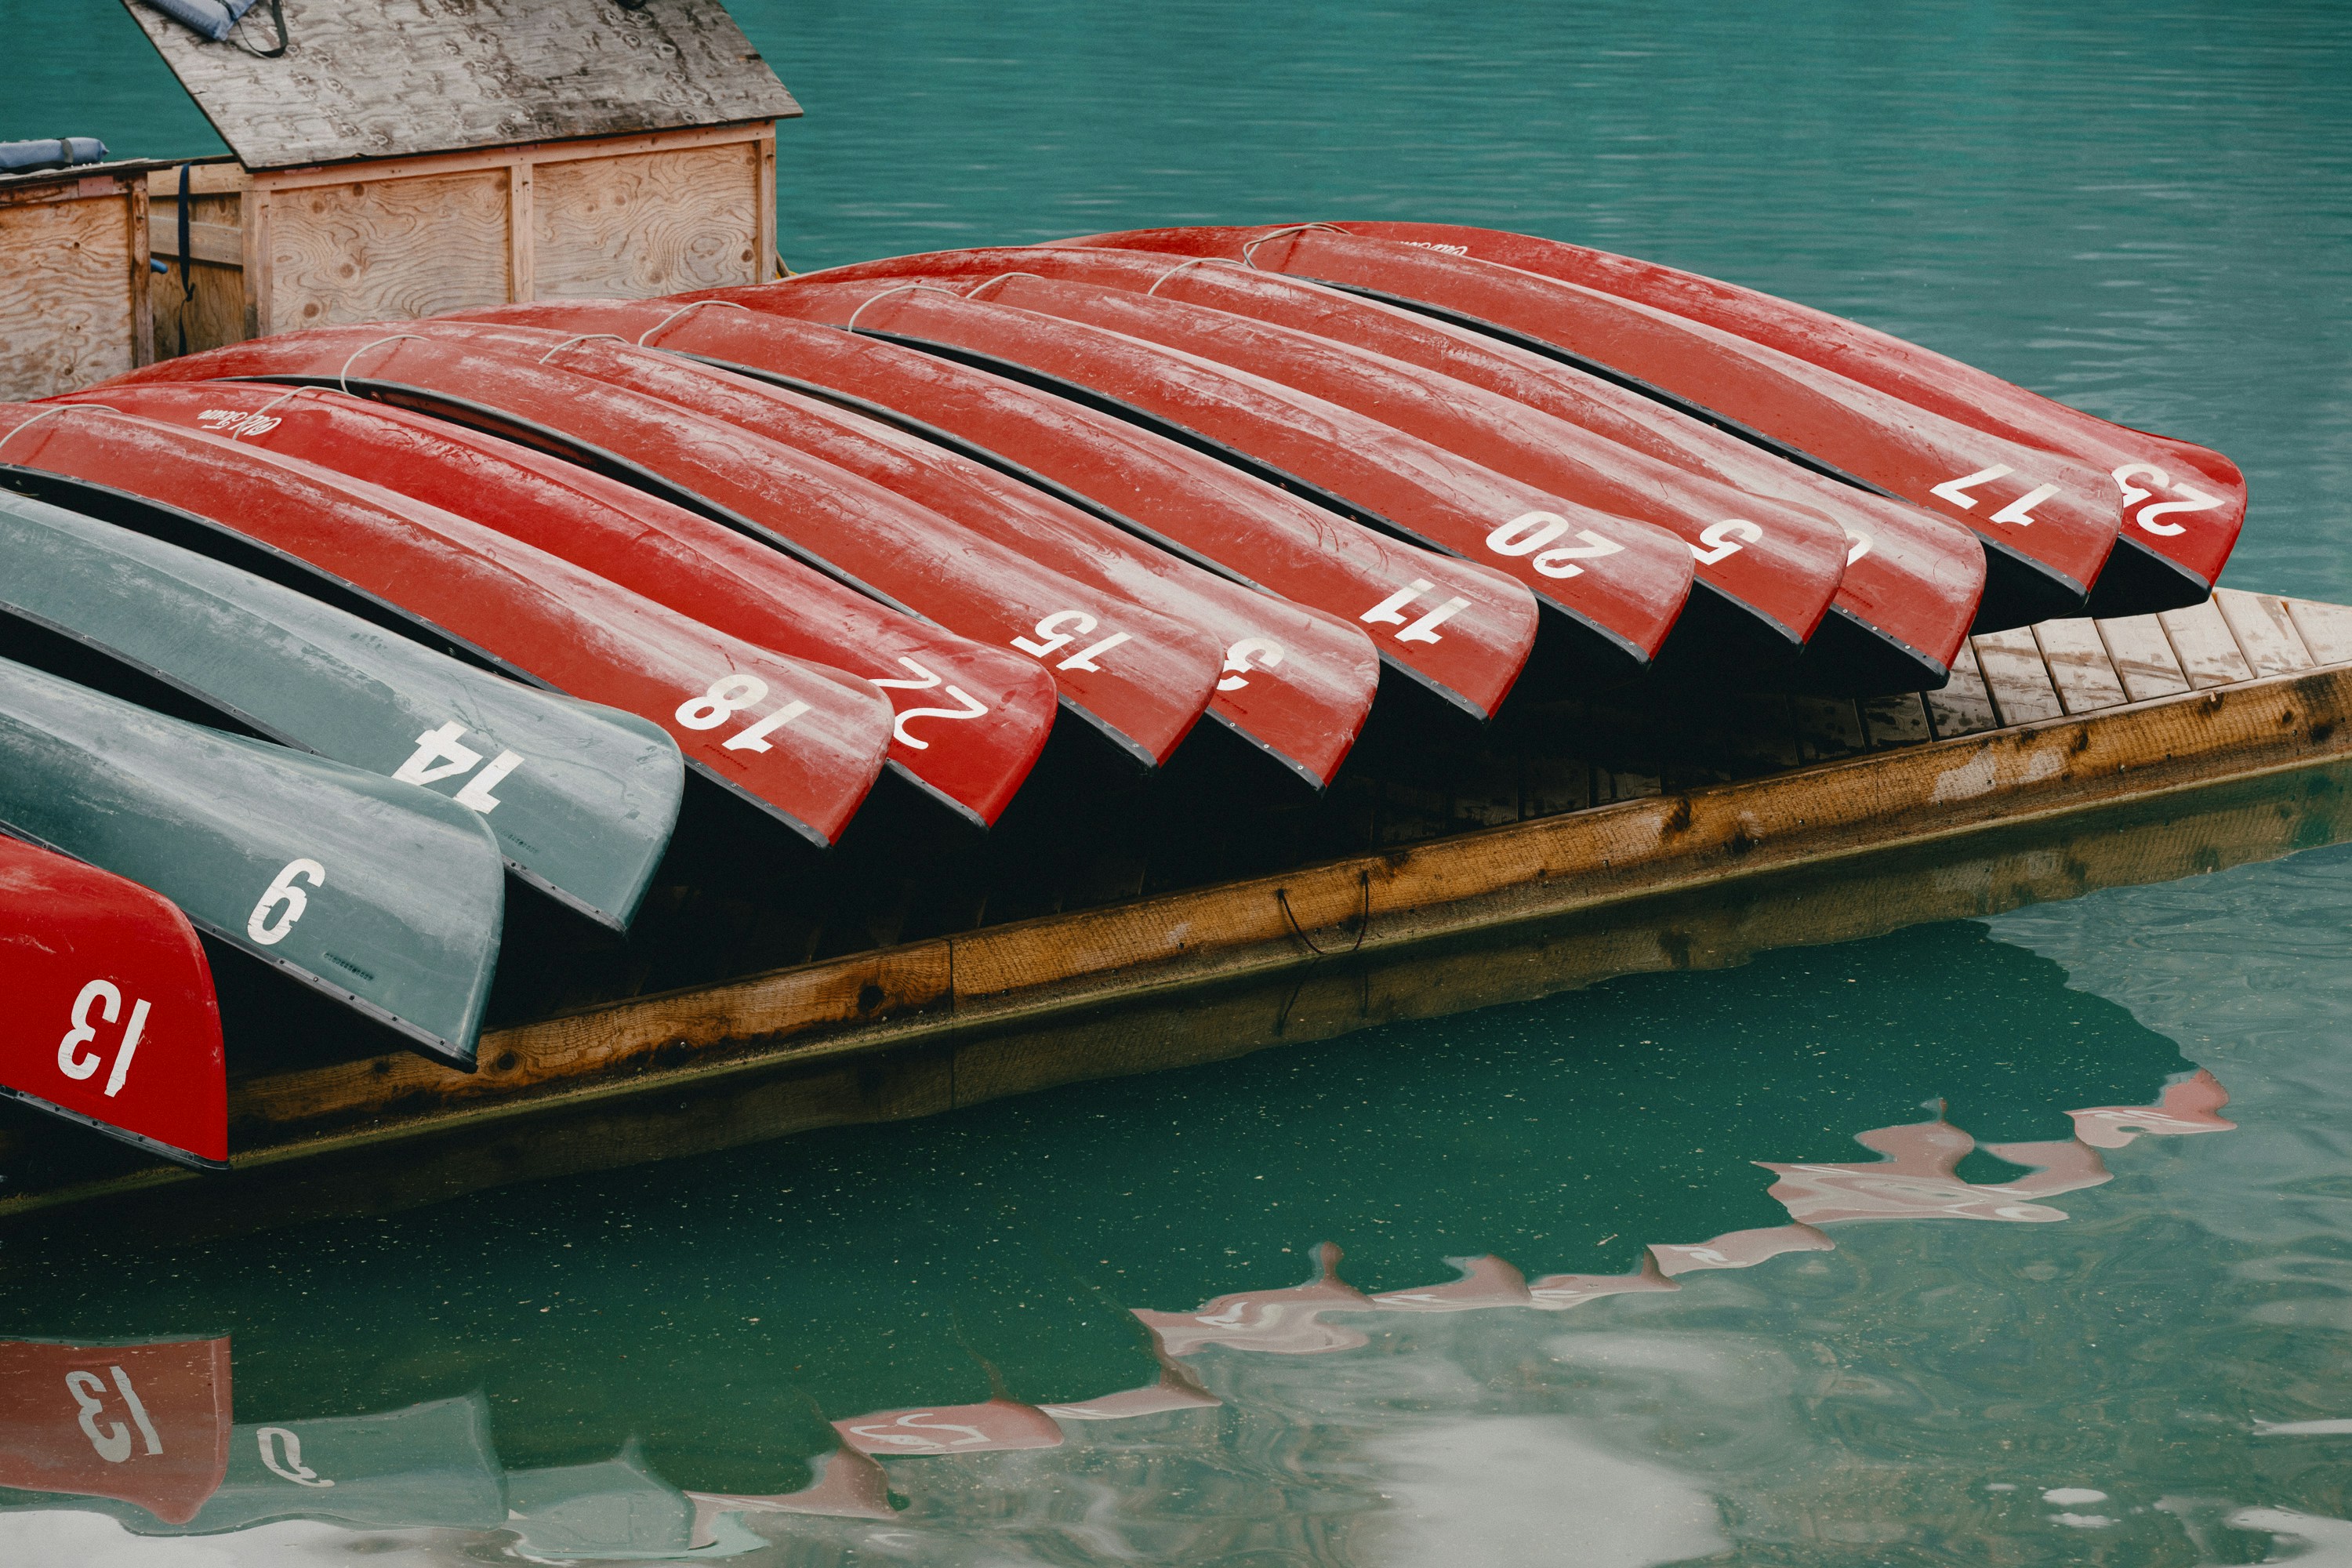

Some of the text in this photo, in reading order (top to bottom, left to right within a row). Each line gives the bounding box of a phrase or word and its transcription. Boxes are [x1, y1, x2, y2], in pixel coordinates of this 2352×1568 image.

[1929, 463, 2061, 527] 17
[2111, 463, 2226, 536] 25
[1485, 510, 1626, 579] 20
[1686, 518, 1764, 566] 5
[1010, 609, 1134, 673] 15
[1359, 578, 1472, 644] 11
[674, 673, 812, 753] 18
[869, 657, 989, 750] 22
[390, 719, 526, 815] 14
[57, 979, 151, 1098] 13
